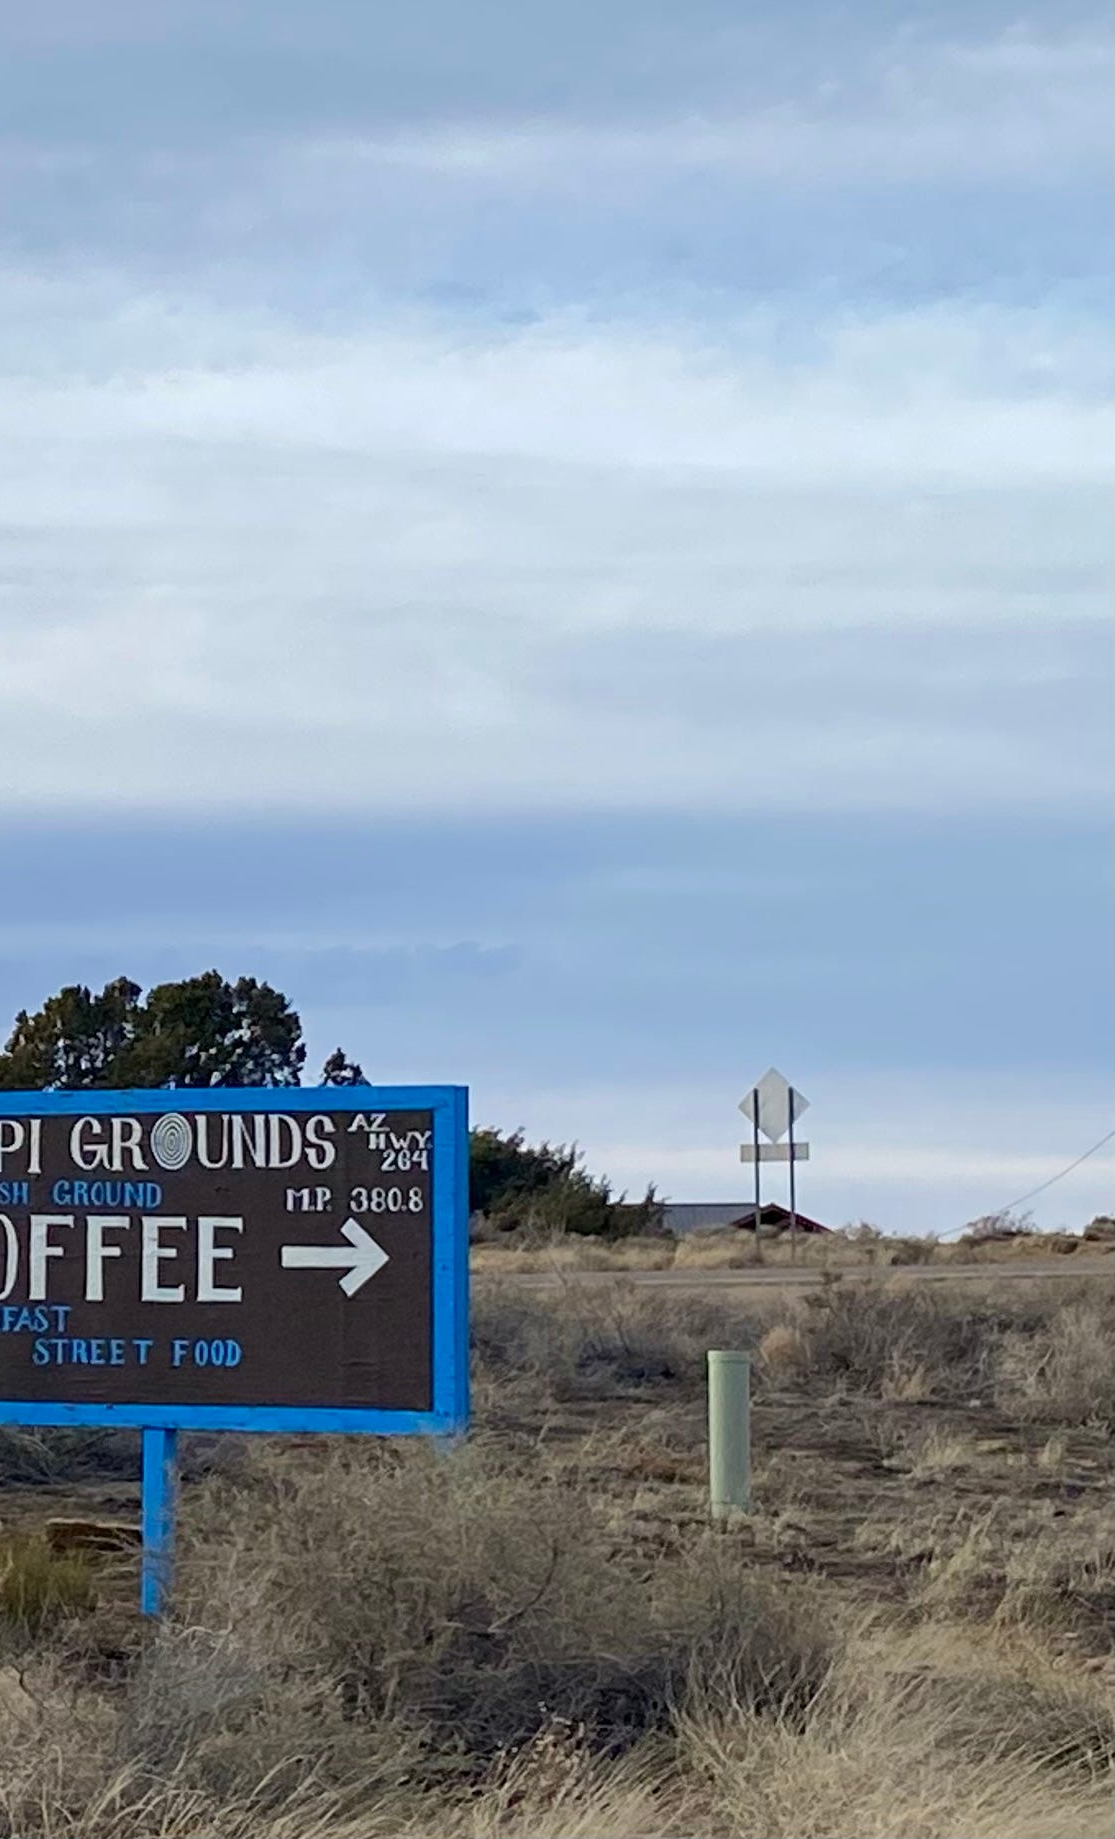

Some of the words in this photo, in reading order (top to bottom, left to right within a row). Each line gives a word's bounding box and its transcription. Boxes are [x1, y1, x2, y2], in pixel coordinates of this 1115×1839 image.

[347, 1113, 390, 1132] AZ
[70, 1112, 336, 1171] GROUNDS
[381, 1150, 429, 1171] 264
[53, 1180, 162, 1208] GROUND
[350, 1186, 424, 1212] 380.8
[32, 1338, 154, 1366] STREET
[172, 1339, 243, 1367] FOOD
